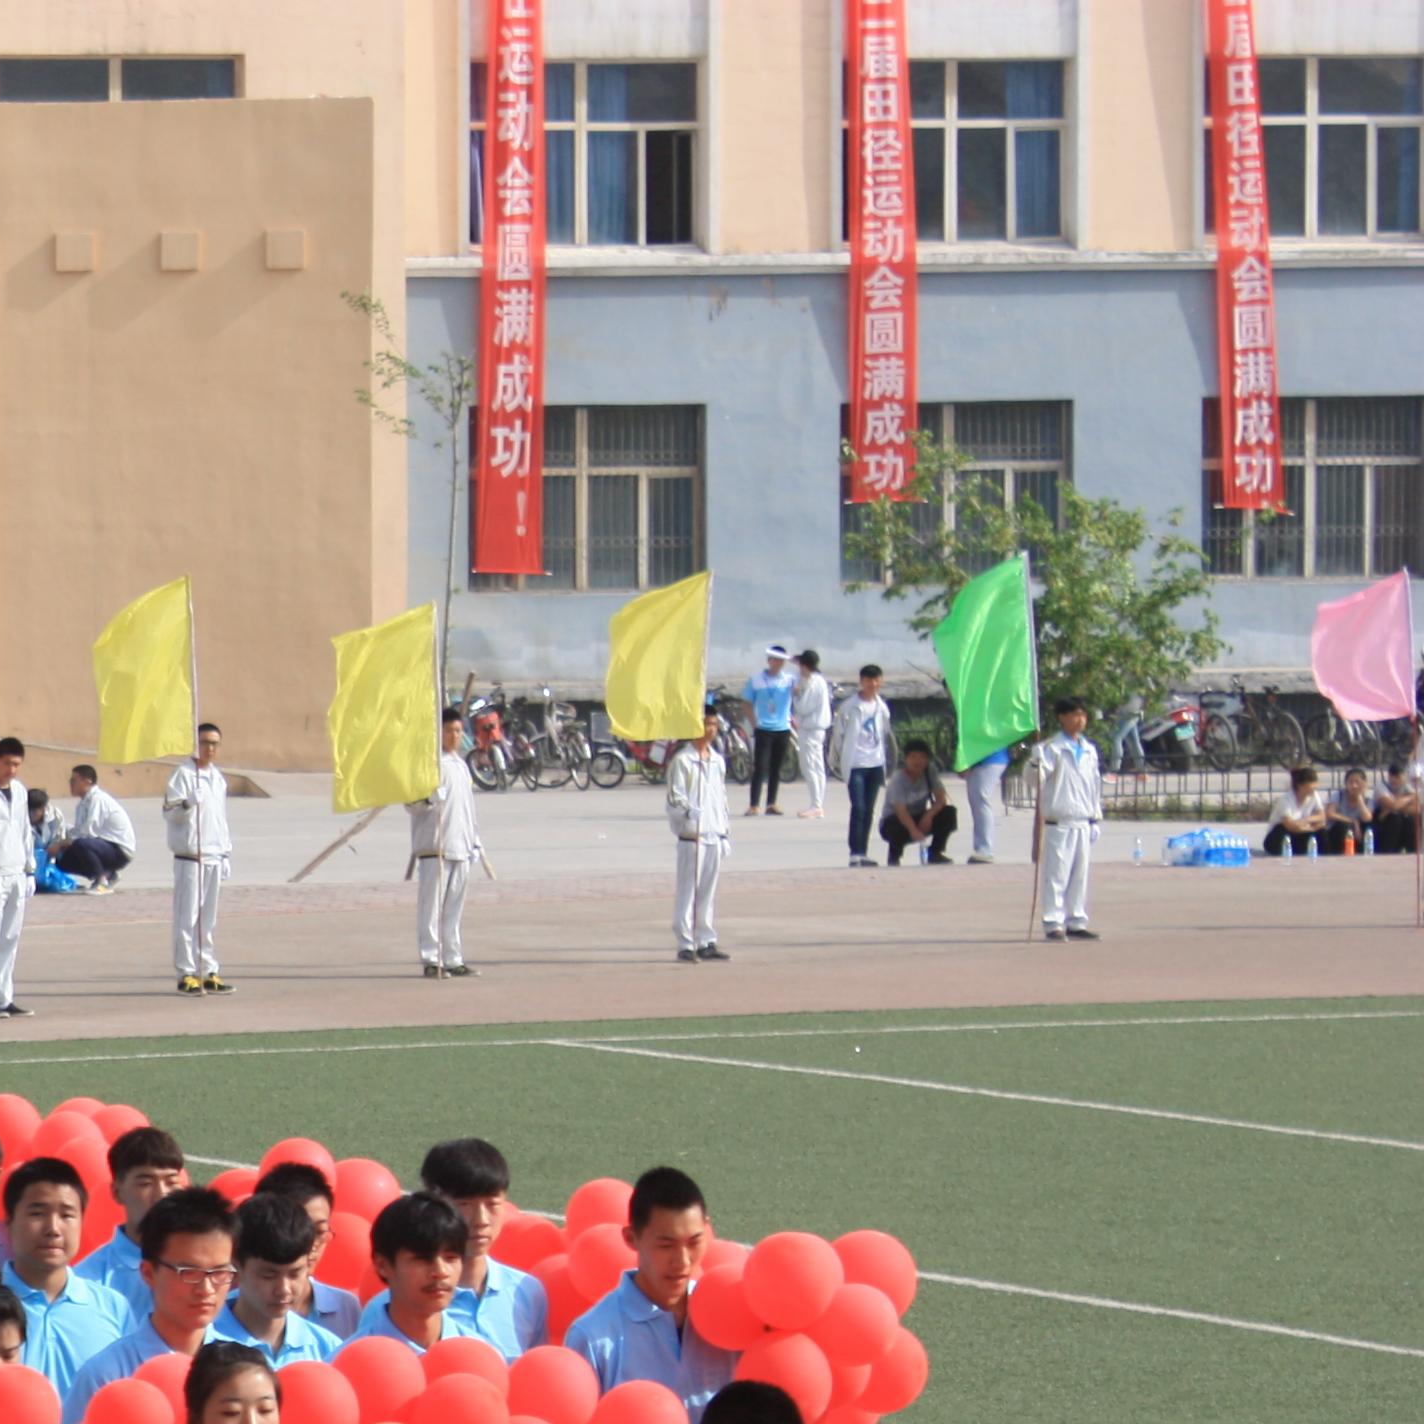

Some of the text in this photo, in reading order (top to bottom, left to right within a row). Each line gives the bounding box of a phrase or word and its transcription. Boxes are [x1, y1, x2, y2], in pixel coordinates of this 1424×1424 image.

[1223, 0, 1275, 494] 届田径运动会圆满成功
